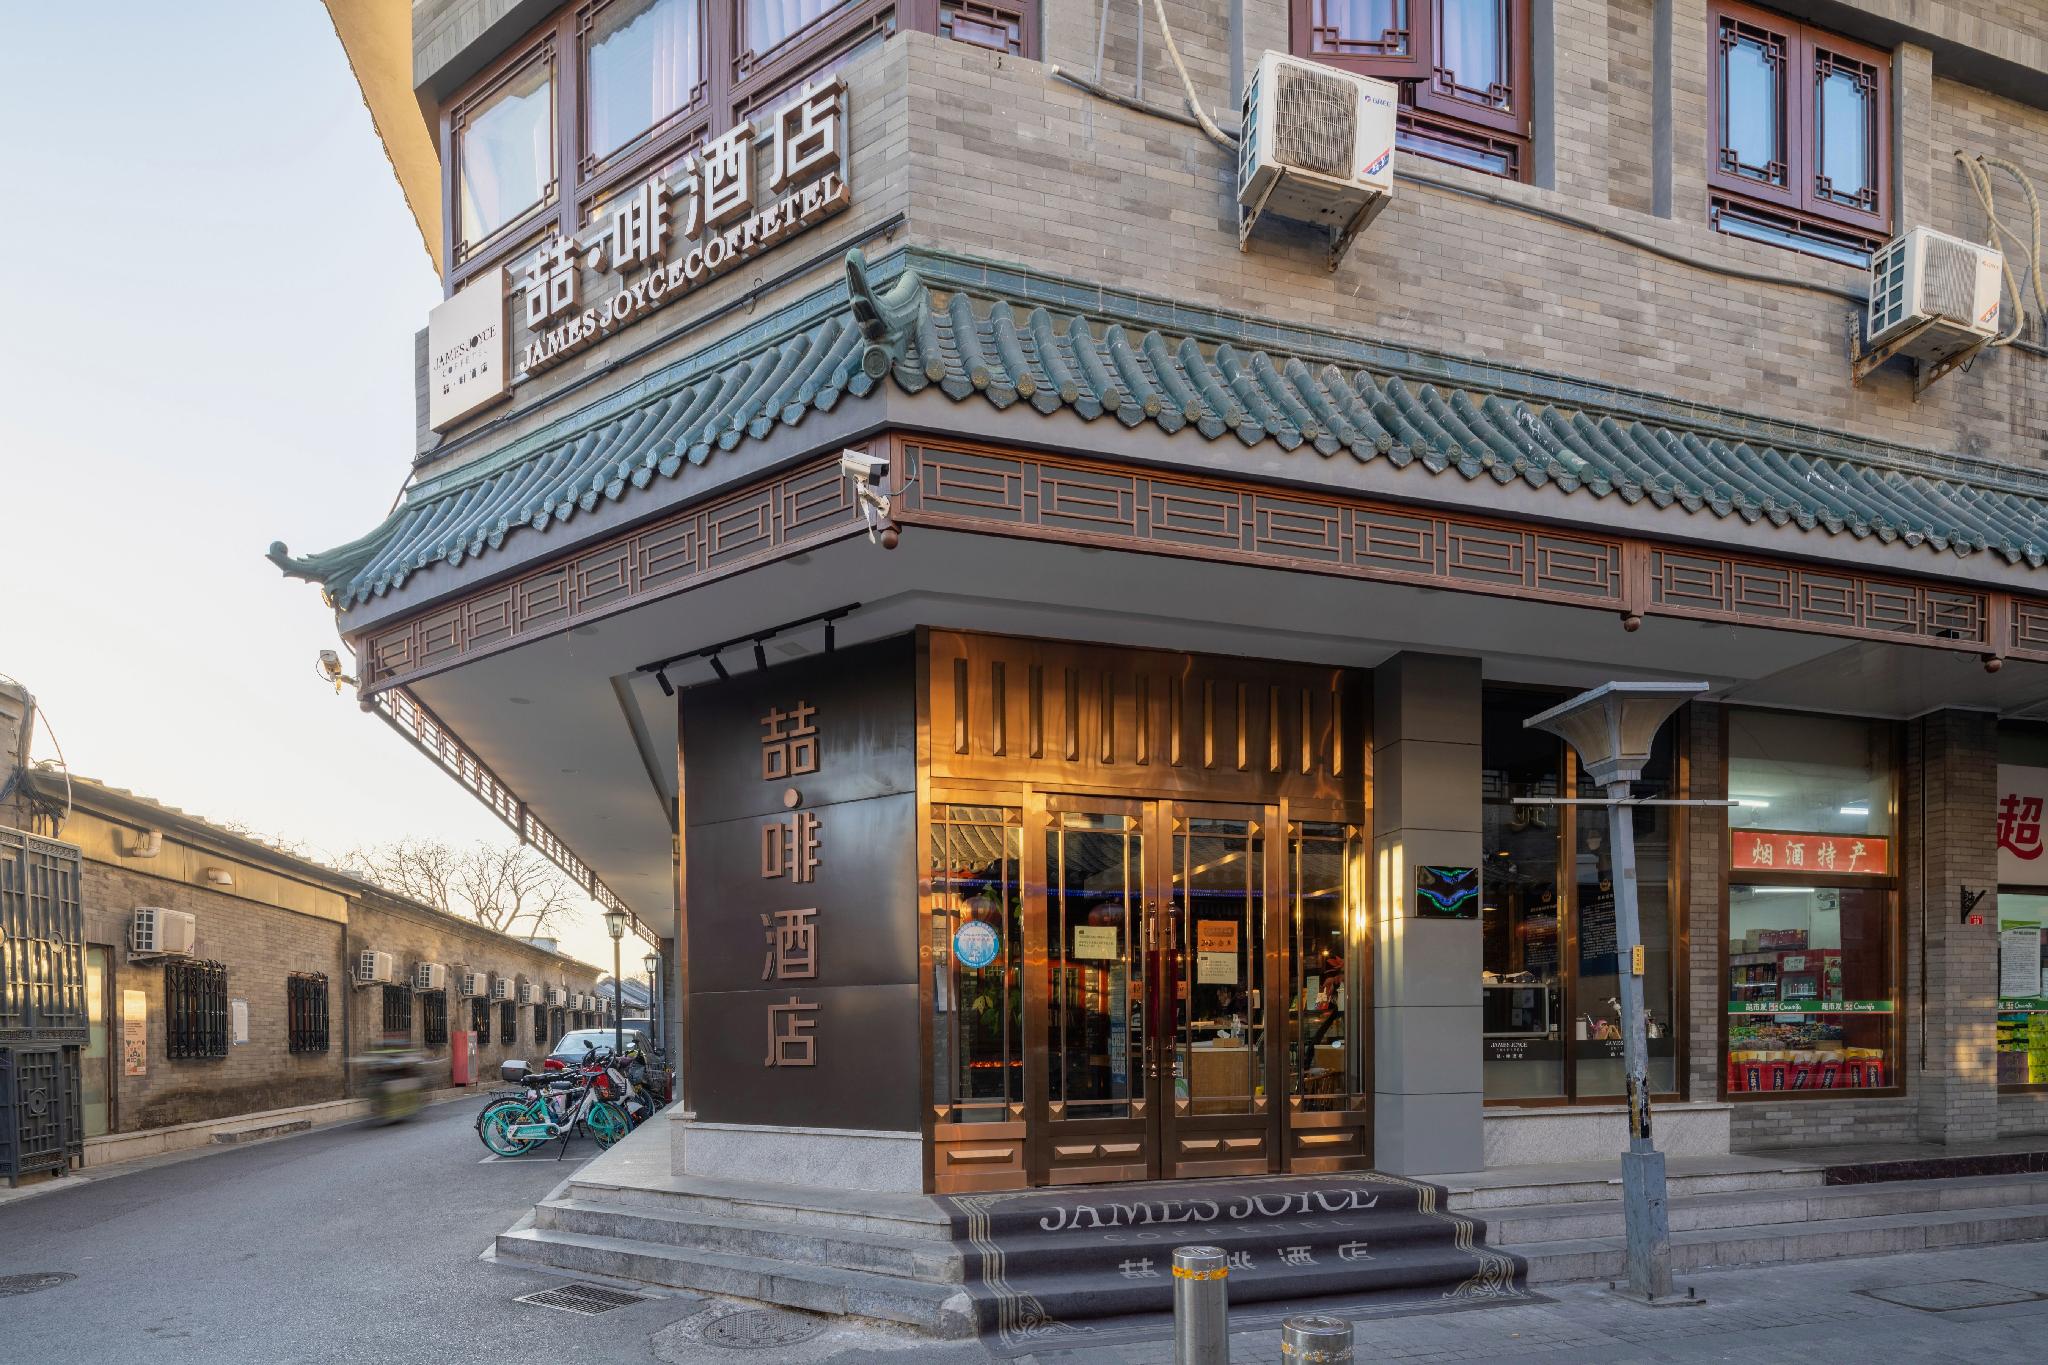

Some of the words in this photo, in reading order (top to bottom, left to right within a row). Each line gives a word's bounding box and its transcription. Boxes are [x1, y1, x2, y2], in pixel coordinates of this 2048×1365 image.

[1997, 794, 2044, 860] 超
[1752, 837, 1867, 872] 烟酒特产
[1039, 1199, 1220, 1231] JAMES
